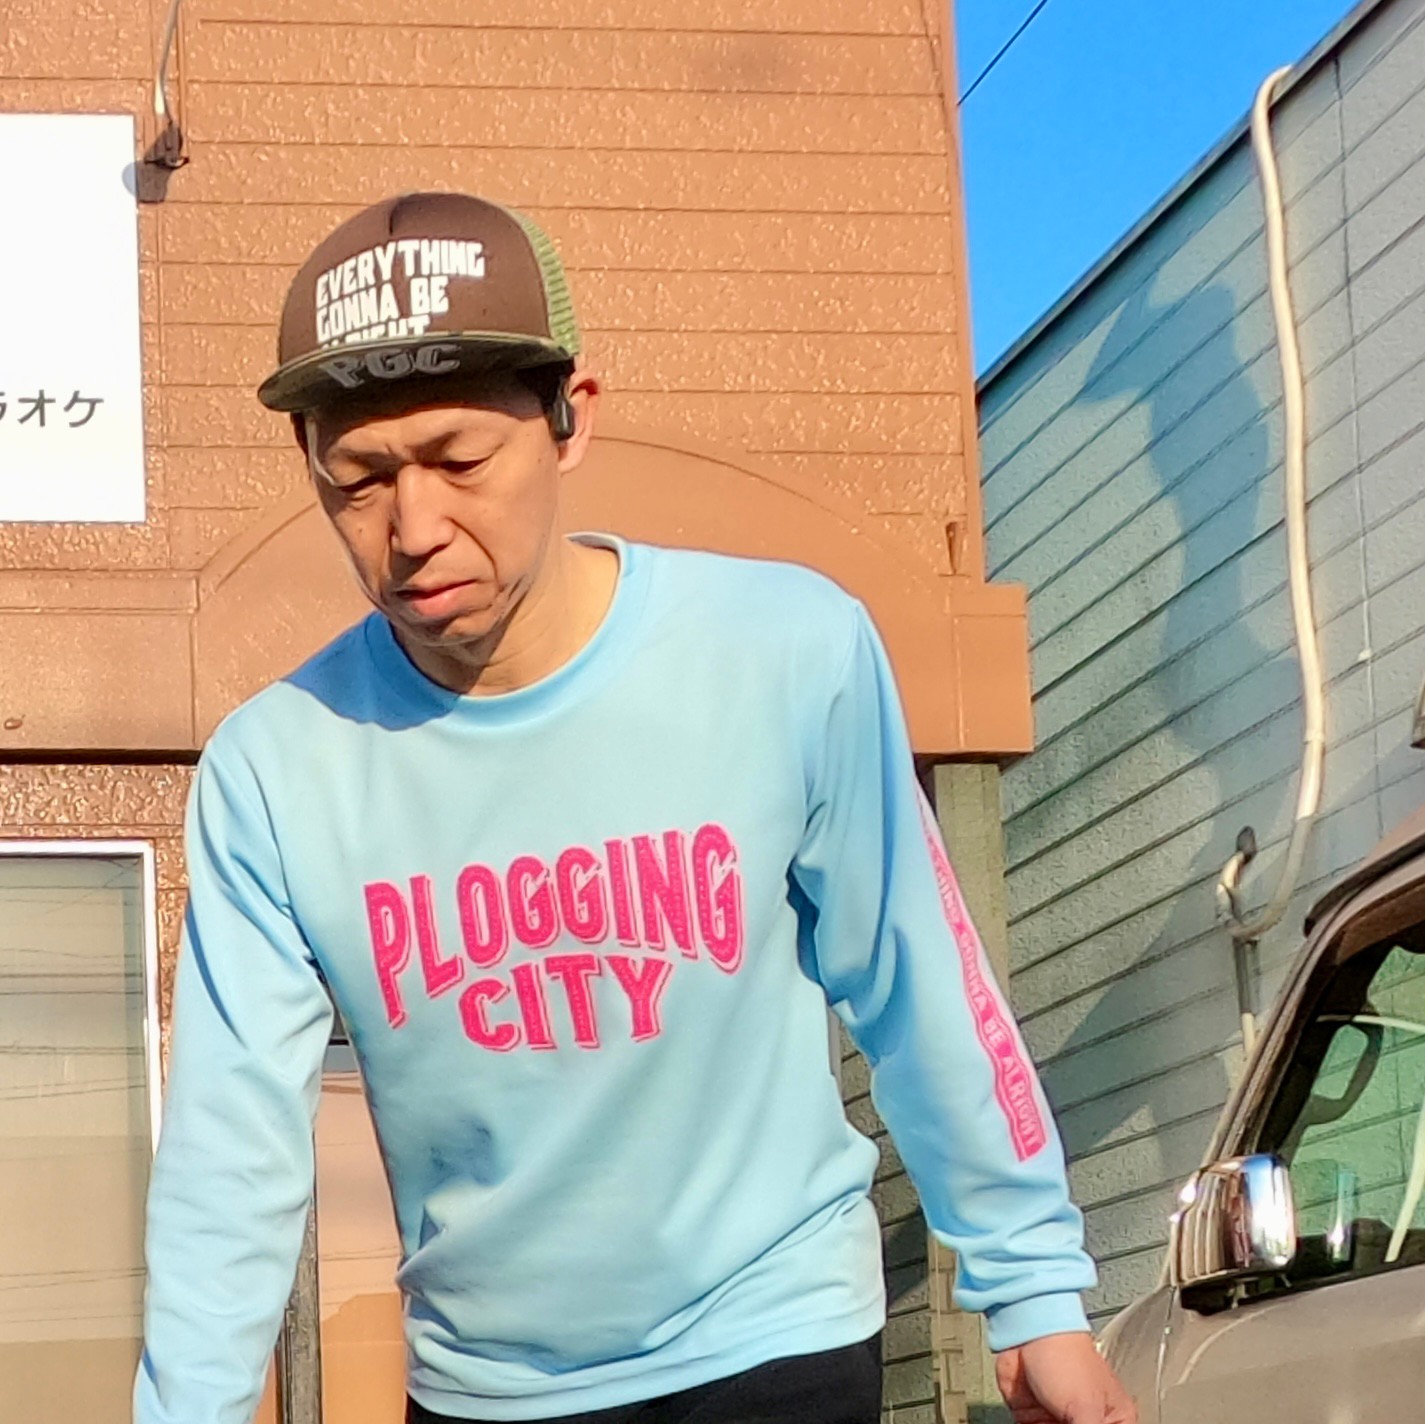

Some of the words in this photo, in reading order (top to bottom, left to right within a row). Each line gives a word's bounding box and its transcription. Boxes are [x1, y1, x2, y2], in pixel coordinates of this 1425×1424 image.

[315, 238, 485, 307] EVERYTHING
[315, 282, 401, 345] GONNA
[410, 275, 450, 316] BE
[317, 343, 462, 389] PGC
[363, 821, 747, 1030] PLOGGING
[457, 952, 673, 1054] CITY
[983, 1016, 1008, 1048] BE
[1000, 1054, 1040, 1146] ALRIGHT
